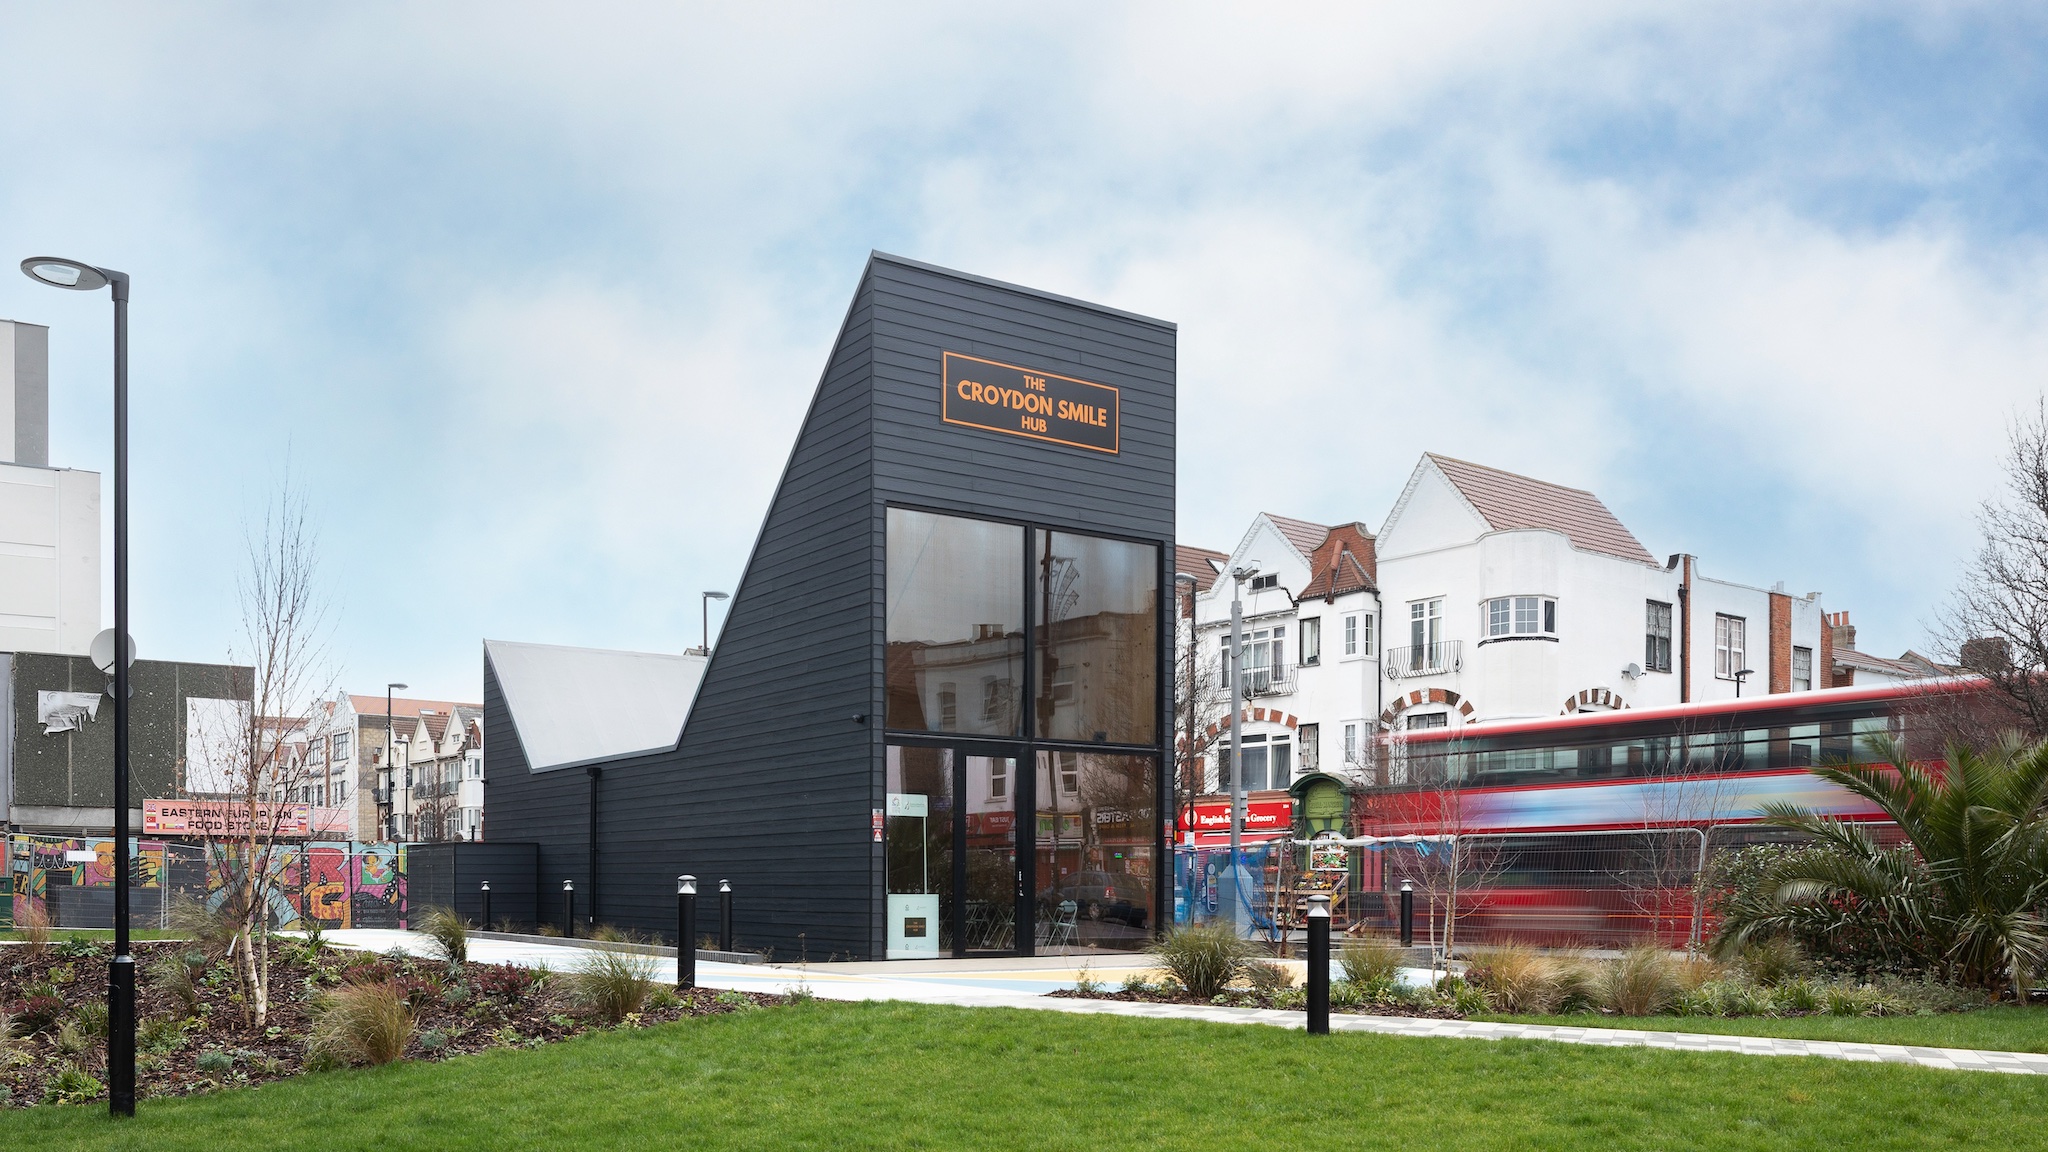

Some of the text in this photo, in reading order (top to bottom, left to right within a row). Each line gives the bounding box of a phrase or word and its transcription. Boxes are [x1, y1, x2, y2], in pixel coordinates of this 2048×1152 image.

[1023, 374, 1046, 392] THE
[957, 379, 1107, 428] CROYDON SMILE
[1021, 415, 1048, 433] HUB
[161, 808, 292, 819] EASTERN EURPAN
[1200, 814, 1225, 827] English
[1250, 813, 1277, 825] Grocery
[188, 821, 222, 830] FOOD
